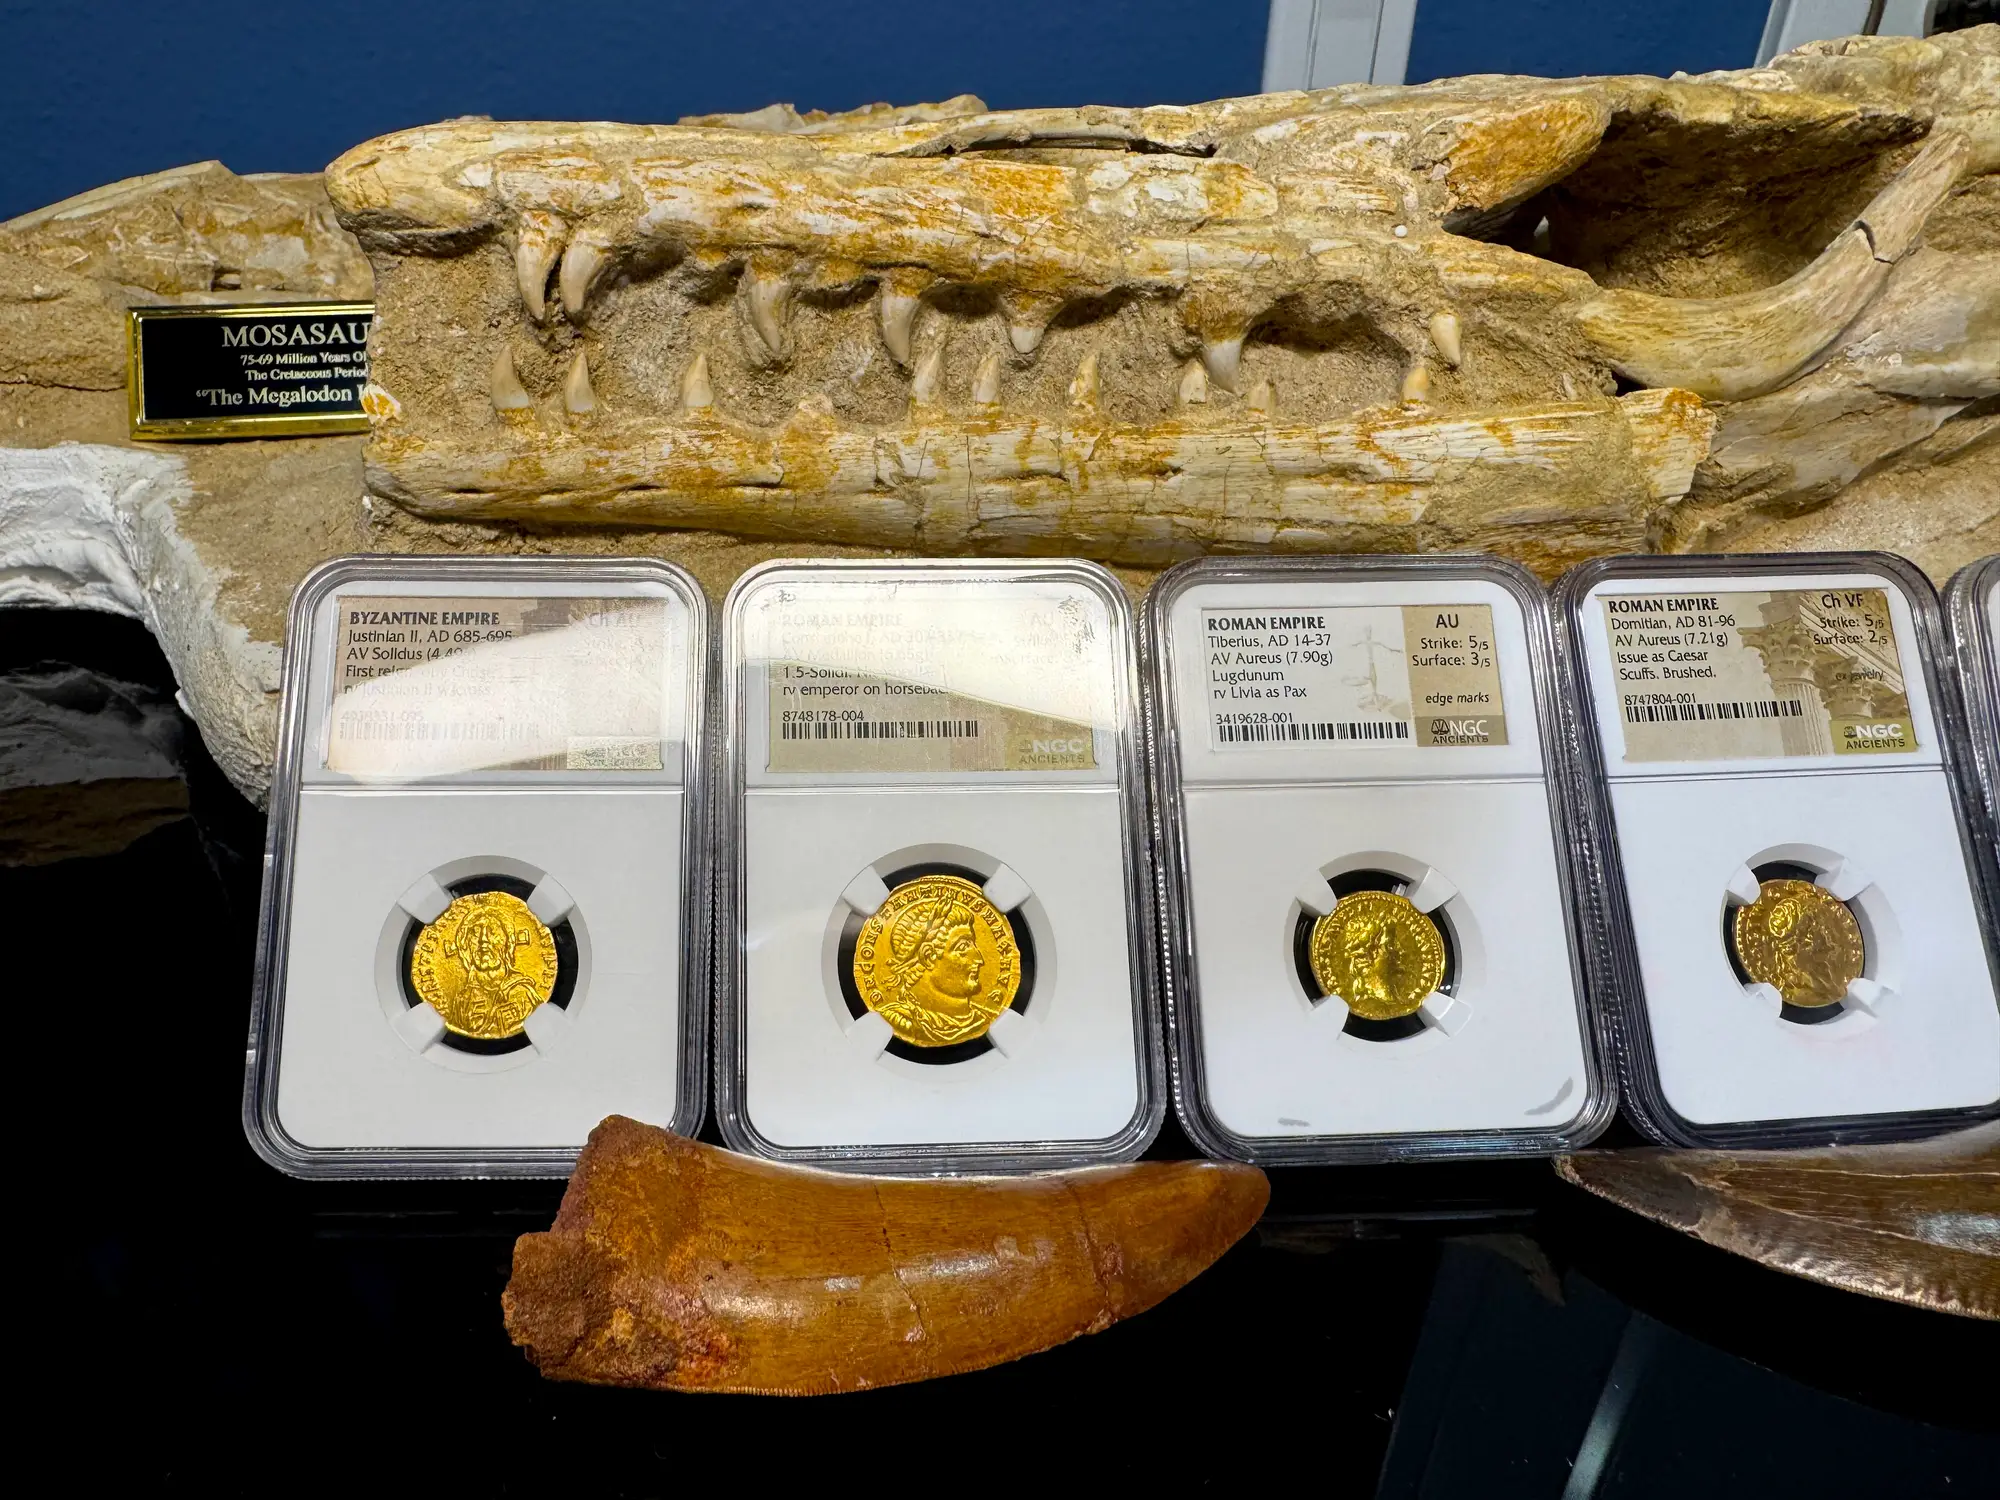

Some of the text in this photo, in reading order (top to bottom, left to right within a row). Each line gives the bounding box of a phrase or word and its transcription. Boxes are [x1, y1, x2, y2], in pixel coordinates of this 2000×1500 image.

[221, 323, 370, 347] MOSASAU
[240, 354, 274, 366] 75-69
[275, 352, 318, 365] Million
[319, 351, 351, 364] Years
[244, 369, 268, 381] The
[269, 368, 333, 381] Cretaceous
[247, 384, 353, 408] Megalodon
[1608, 598, 1719, 613] ROMAN EMPIRE
[1821, 593, 1863, 609] Ch VF
[349, 611, 500, 625] BYZANTINE EMPIRE
[1207, 616, 1326, 631] ROMAN EMPIRE
[1435, 613, 1459, 628] AU
[1611, 614, 1736, 630] Domitian, AD 81-96
[1819, 616, 1860, 629] Strike:
[347, 630, 405, 645] Justinian
[427, 630, 450, 643] AD
[453, 630, 512, 643] 685-695
[1207, 633, 1331, 649] Tiberius, AD 14-37
[1420, 637, 1463, 650] Strike:
[1615, 631, 1728, 647] AV Aureus (7.21g)
[1813, 633, 1863, 645] Surface:
[346, 648, 368, 660] AV
[372, 648, 423, 660] Solidus
[1210, 650, 1333, 667] AV Aureus (7.90g)
[1412, 652, 1466, 667] Surface:
[1617, 649, 1709, 663] Issue as Caesar
[345, 665, 374, 677] First
[1212, 669, 1285, 685] Lugdunum
[1619, 665, 1717, 681] Scuffs. Brushed.
[783, 686, 797, 696] rv
[800, 685, 858, 699] emperor
[863, 685, 880, 695] on
[1213, 685, 1307, 699] rv Livia as Pax
[1425, 691, 1490, 707] edge marks
[1624, 693, 1697, 706] 8747804-001
[782, 710, 865, 722] 8748178-004
[1215, 712, 1293, 725] 3419628-001
[1449, 720, 1489, 736] NGC
[1856, 723, 1904, 738] NGC
[1032, 739, 1083, 753] NGC
[1431, 734, 1489, 745] ANCIENTS
[1846, 737, 1905, 750] ANCIENTS
[1019, 754, 1085, 765] ANCIENTS
